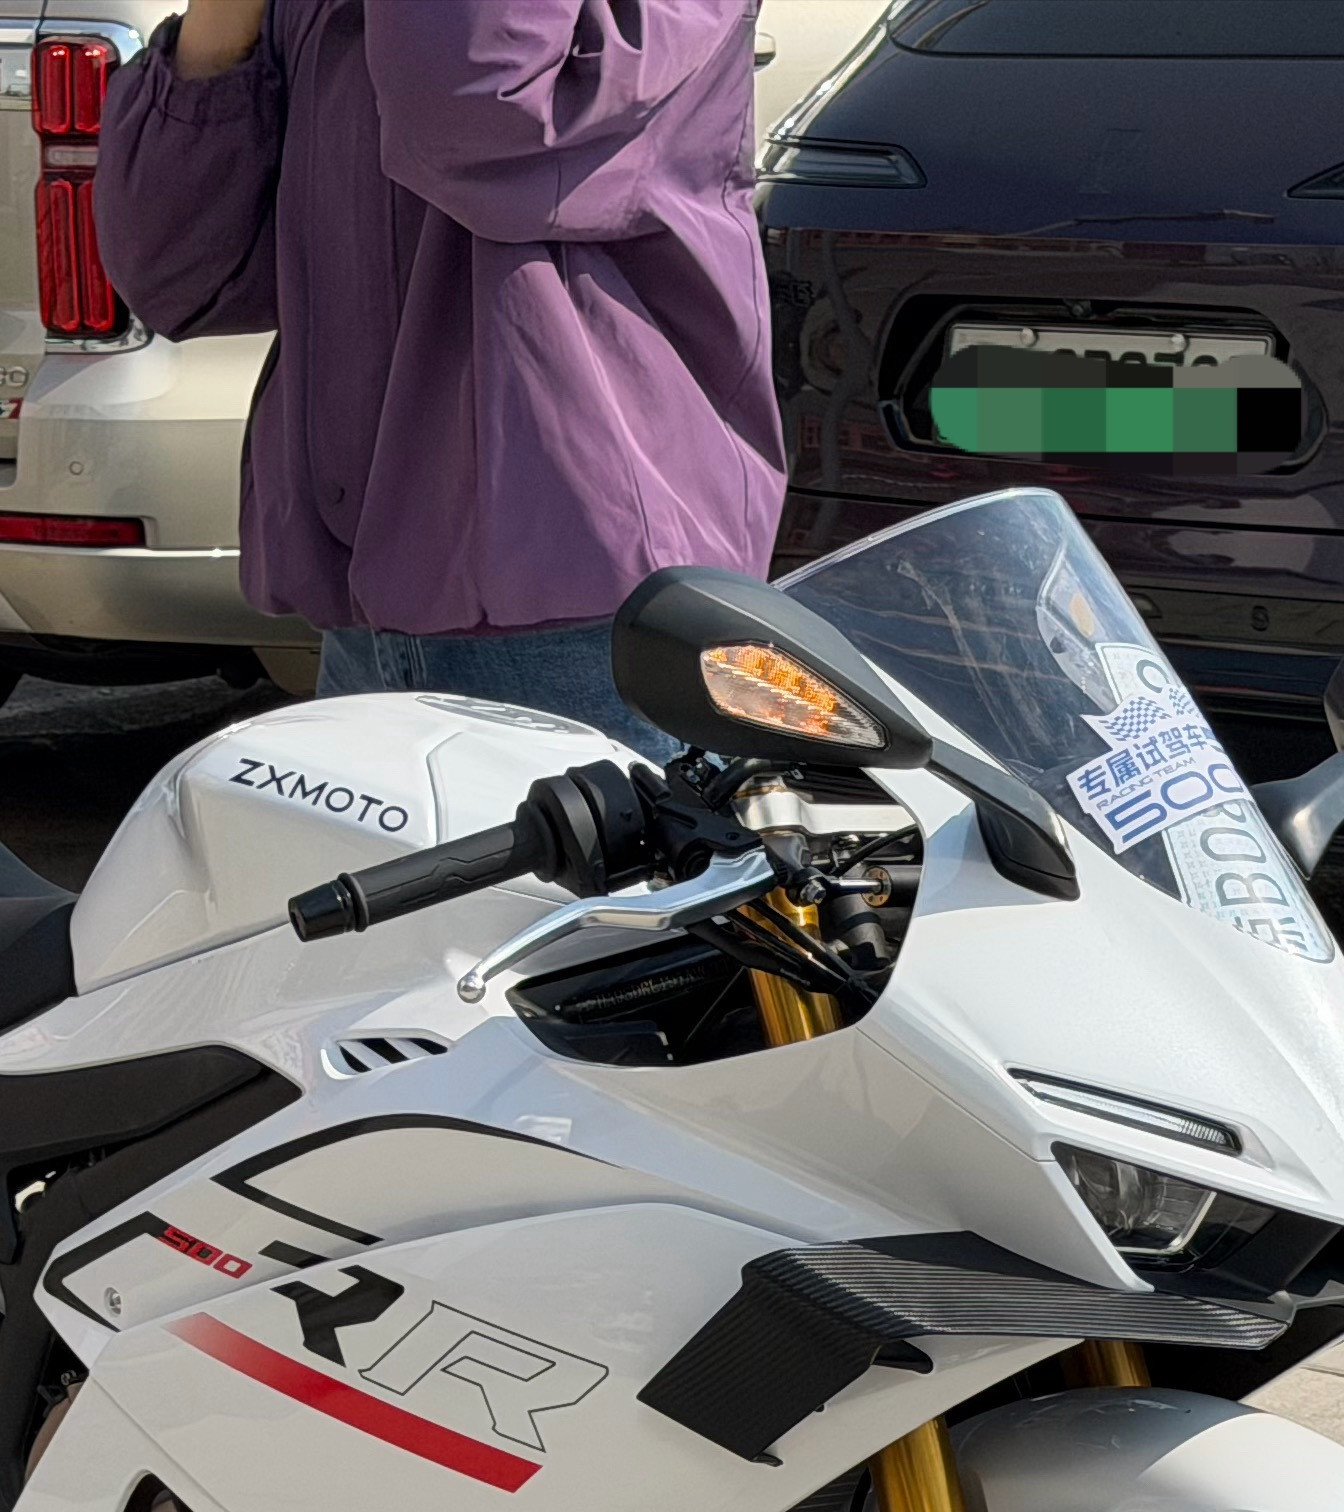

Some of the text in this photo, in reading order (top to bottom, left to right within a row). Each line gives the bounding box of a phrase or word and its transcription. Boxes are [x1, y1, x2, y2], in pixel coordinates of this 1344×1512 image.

[228, 757, 410, 833] ZXMOTO
[1096, 757, 1196, 811] RACING TEAM
